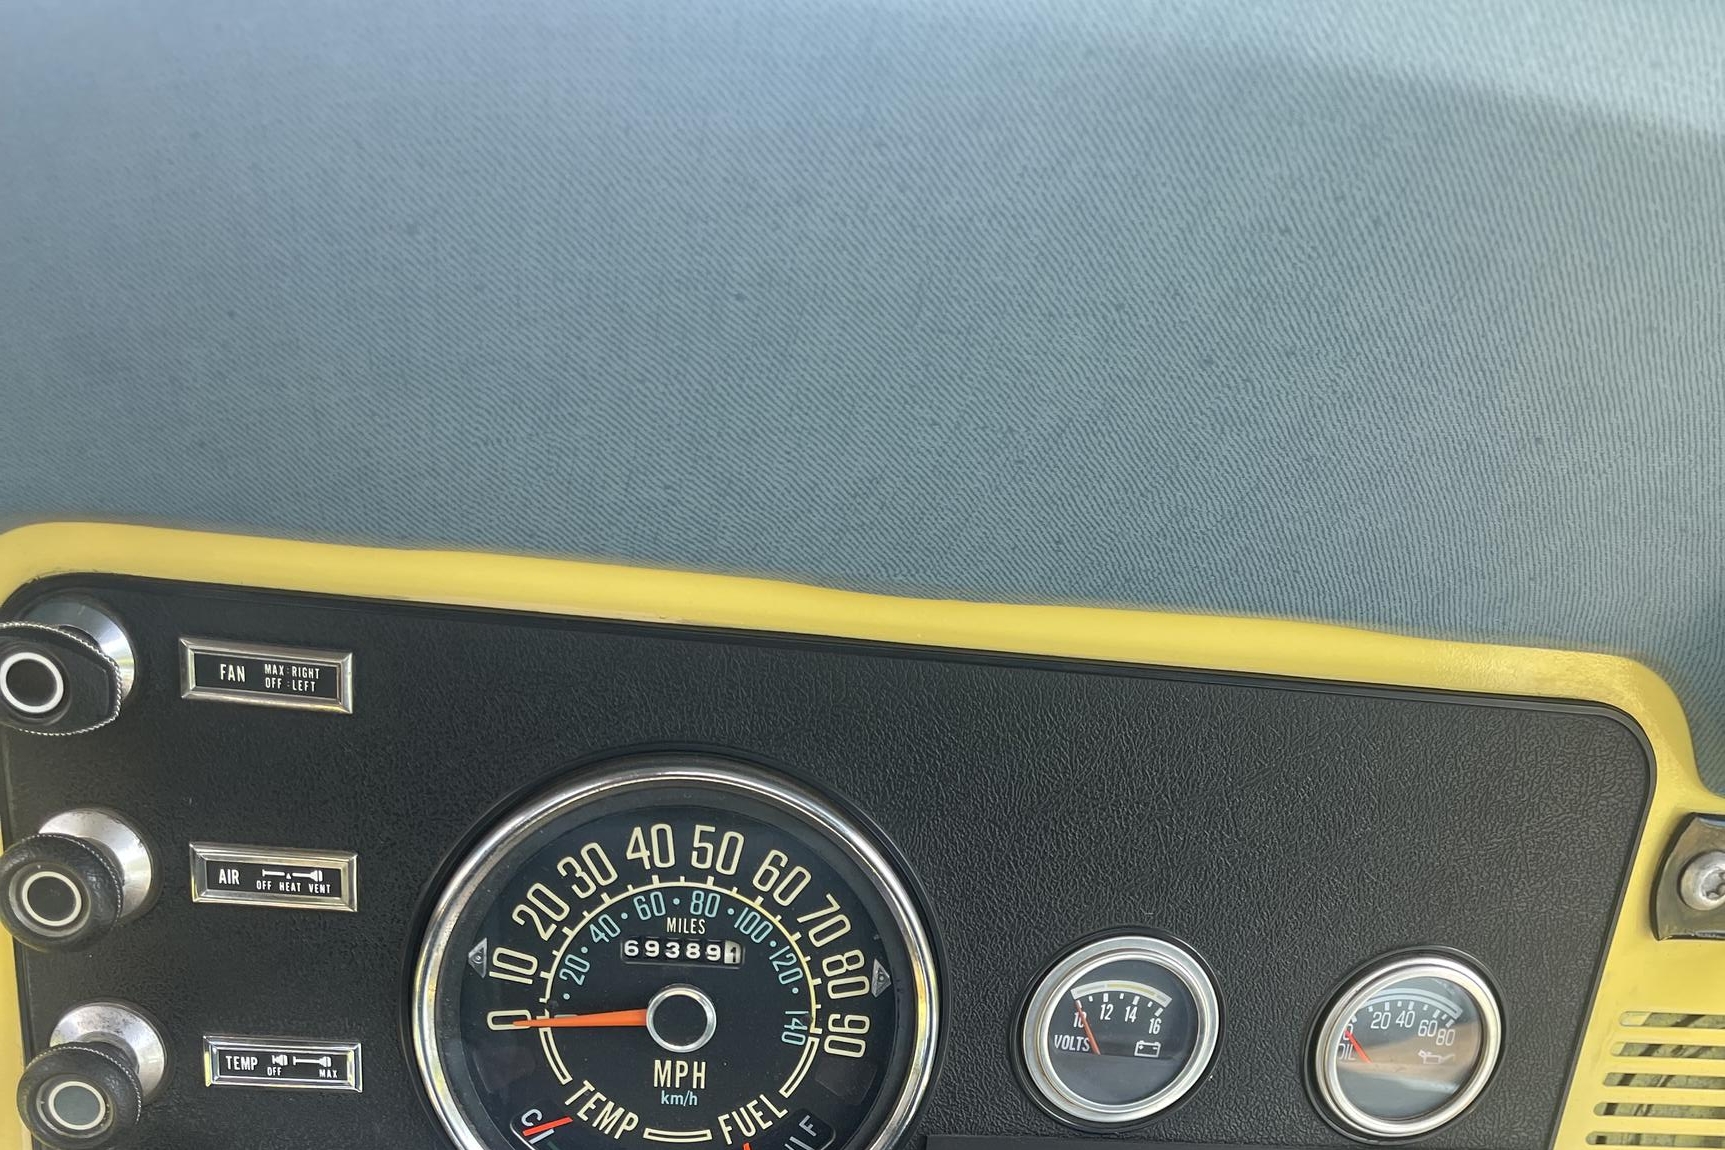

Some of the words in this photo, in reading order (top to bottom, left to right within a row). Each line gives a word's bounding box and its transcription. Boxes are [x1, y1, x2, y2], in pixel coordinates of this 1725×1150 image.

[220, 663, 245, 682] FAN
[626, 823, 676, 870] 40
[691, 824, 745, 875] 50
[219, 869, 240, 885] AIR
[556, 842, 619, 899] 30
[752, 849, 812, 907] 60
[256, 880, 272, 890] OFF
[279, 882, 301, 892] HEAT
[308, 883, 331, 894] VENT
[512, 882, 571, 941] 20
[633, 891, 667, 921] 60
[690, 890, 721, 918] 80
[589, 913, 621, 943] 40
[666, 917, 706, 935] MILES
[734, 907, 774, 944] 100
[797, 893, 851, 948] 70
[489, 947, 538, 985] 10
[559, 953, 590, 986] 20
[769, 945, 803, 985] 120
[822, 949, 870, 999] 80
[487, 1009, 532, 1030] 0
[1100, 1004, 1114, 1020] 12
[1125, 1006, 1137, 1023] 14
[1371, 1011, 1391, 1029] 20
[1396, 1011, 1415, 1028] 40
[781, 1010, 809, 1046] 140
[823, 1013, 871, 1058] 90
[1149, 1018, 1161, 1035] 16
[1418, 1020, 1438, 1037] 60
[1436, 1029, 1455, 1046] 80
[1054, 1035, 1090, 1052] VOLTS
[225, 1055, 258, 1071] TEMP
[267, 1066, 282, 1076] OFF
[319, 1069, 338, 1078] MAX
[653, 1060, 706, 1089] MPH
[564, 1079, 640, 1140] TEMP
[660, 1090, 698, 1107] km/h
[521, 1108, 543, 1127] C
[717, 1094, 789, 1145] FUEL
[799, 1114, 818, 1137] F
